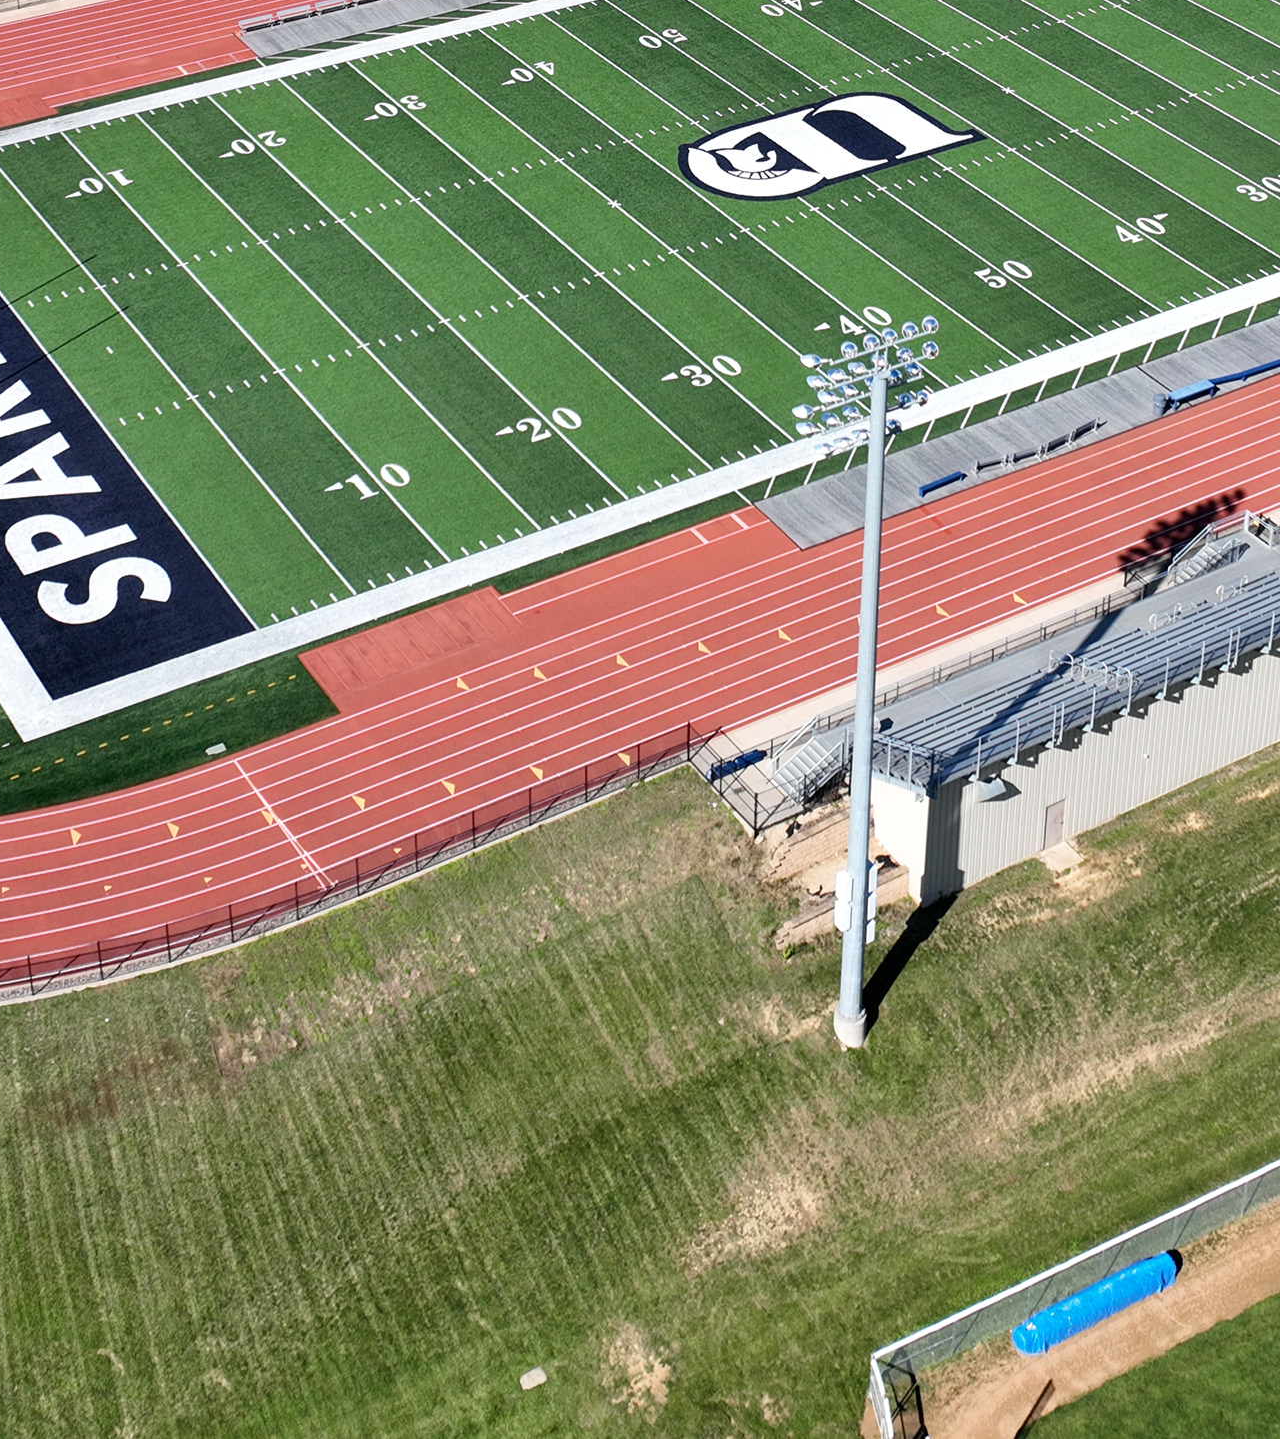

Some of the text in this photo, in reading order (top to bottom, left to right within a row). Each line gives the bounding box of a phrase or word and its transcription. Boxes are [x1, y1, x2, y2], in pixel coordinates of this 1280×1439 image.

[639, 28, 688, 49] 50
[510, 61, 555, 82] 40
[375, 94, 427, 117] 30
[230, 130, 287, 155] 20
[79, 168, 134, 194] 10
[1116, 217, 1166, 244] 40
[974, 260, 1033, 289] 50
[839, 305, 893, 336] 40
[679, 354, 742, 387] 30
[515, 406, 583, 443] 20
[344, 462, 411, 501] 10
